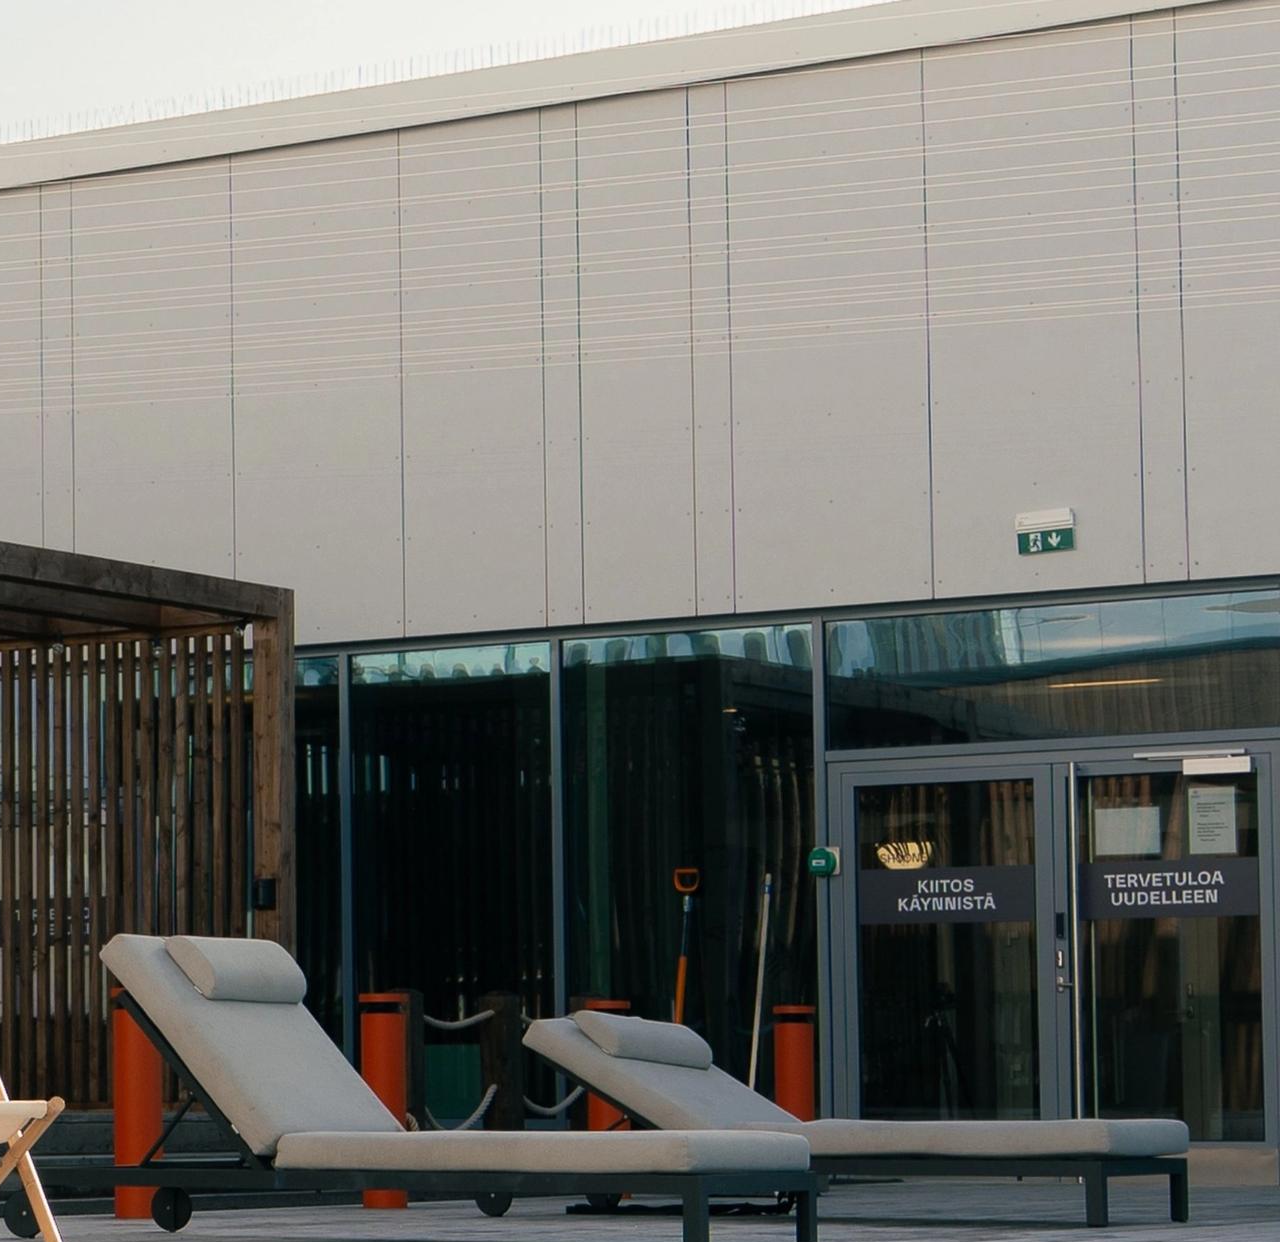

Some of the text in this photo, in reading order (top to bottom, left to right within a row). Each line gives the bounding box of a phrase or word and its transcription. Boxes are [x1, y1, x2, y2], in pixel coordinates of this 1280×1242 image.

[917, 879, 975, 894] KIITOS
[1103, 870, 1225, 889] TERVETULOA
[897, 892, 997, 912] KÄYNNISTÄ
[1110, 889, 1218, 906] UUDELLEEN
